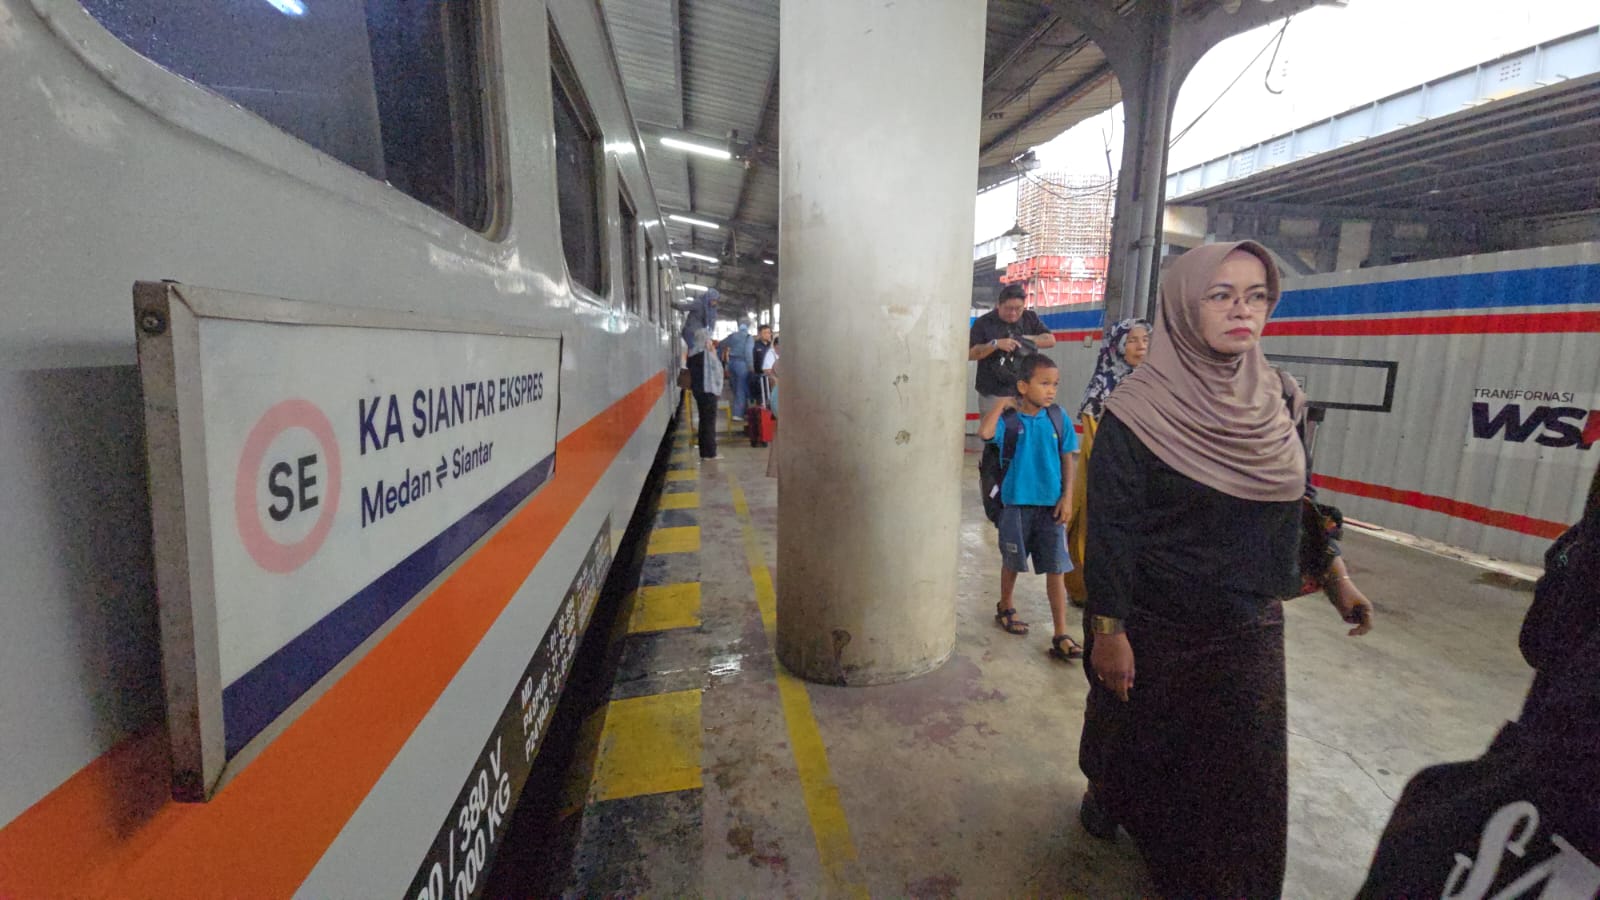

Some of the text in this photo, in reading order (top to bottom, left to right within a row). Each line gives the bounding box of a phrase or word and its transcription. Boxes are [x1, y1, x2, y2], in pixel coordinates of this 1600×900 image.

[358, 372, 544, 455] KA SIANTAR EKSPRES
[268, 454, 319, 521] SE
[361, 439, 494, 528] Medan Siantar
[458, 769, 489, 852] 380
[489, 735, 502, 781] V
[488, 772, 511, 844] KG
